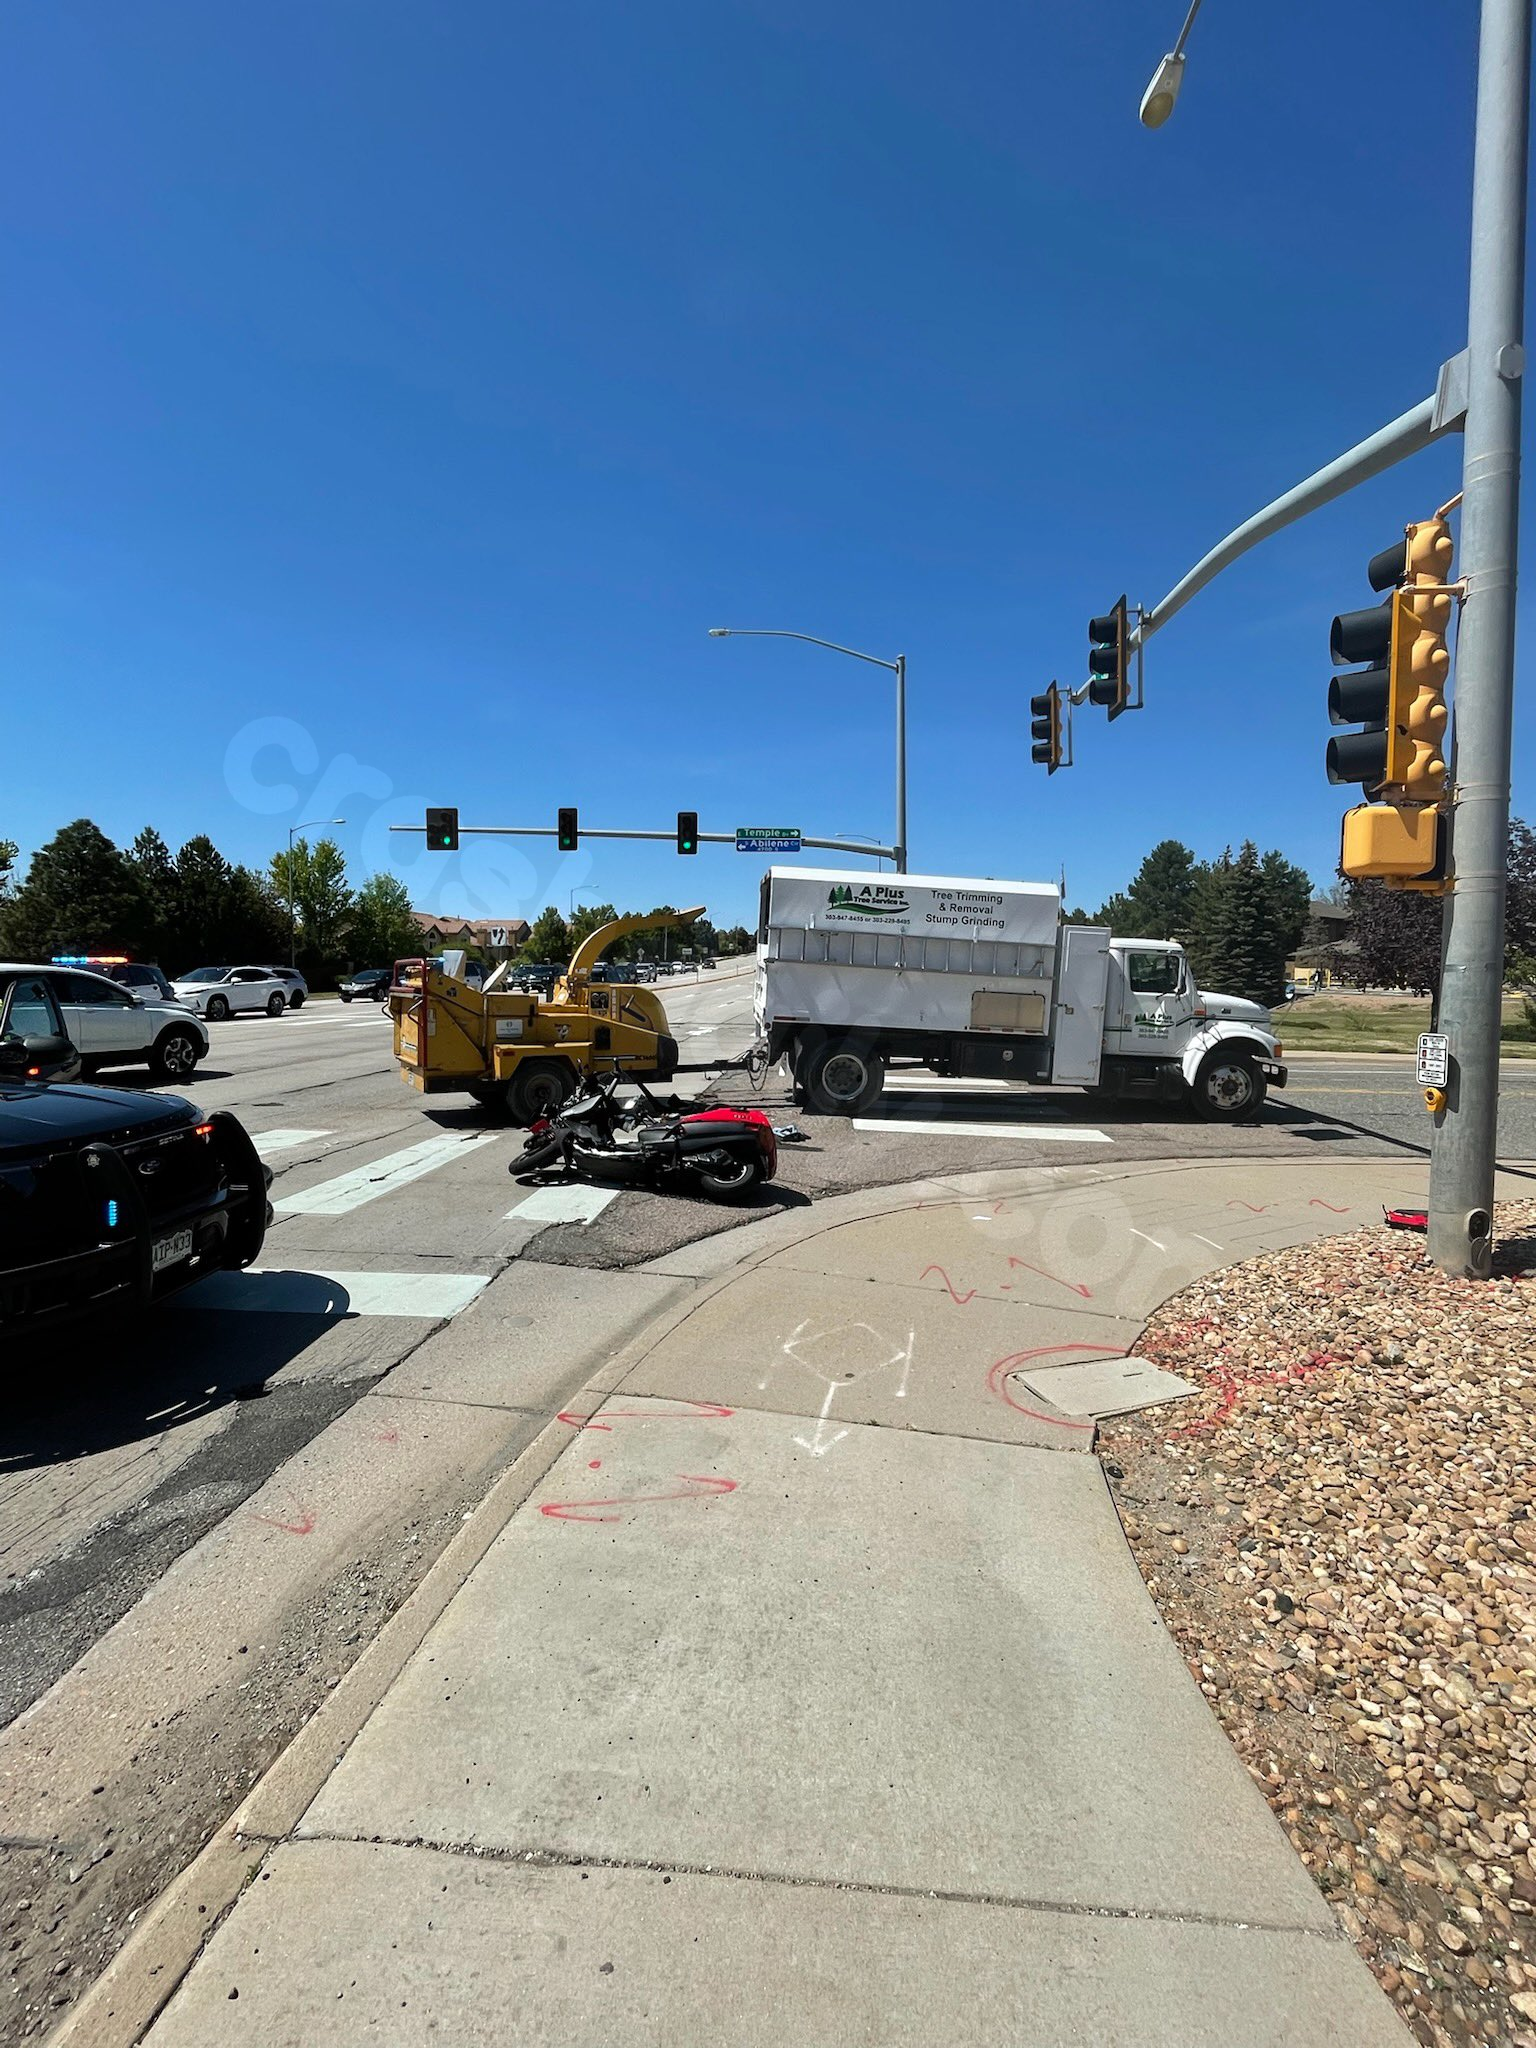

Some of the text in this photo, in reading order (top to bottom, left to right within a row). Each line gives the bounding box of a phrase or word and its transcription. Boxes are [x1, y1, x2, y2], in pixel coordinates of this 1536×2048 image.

[743, 829, 780, 837] Temple
[749, 840, 790, 848] Abilene
[860, 886, 905, 899] A Plus
[931, 890, 1003, 905] Tree Trimming
[854, 896, 871, 904] Tree
[872, 897, 898, 905] Service
[939, 902, 994, 914] & Removal
[925, 914, 1005, 929] Stump Grinding
